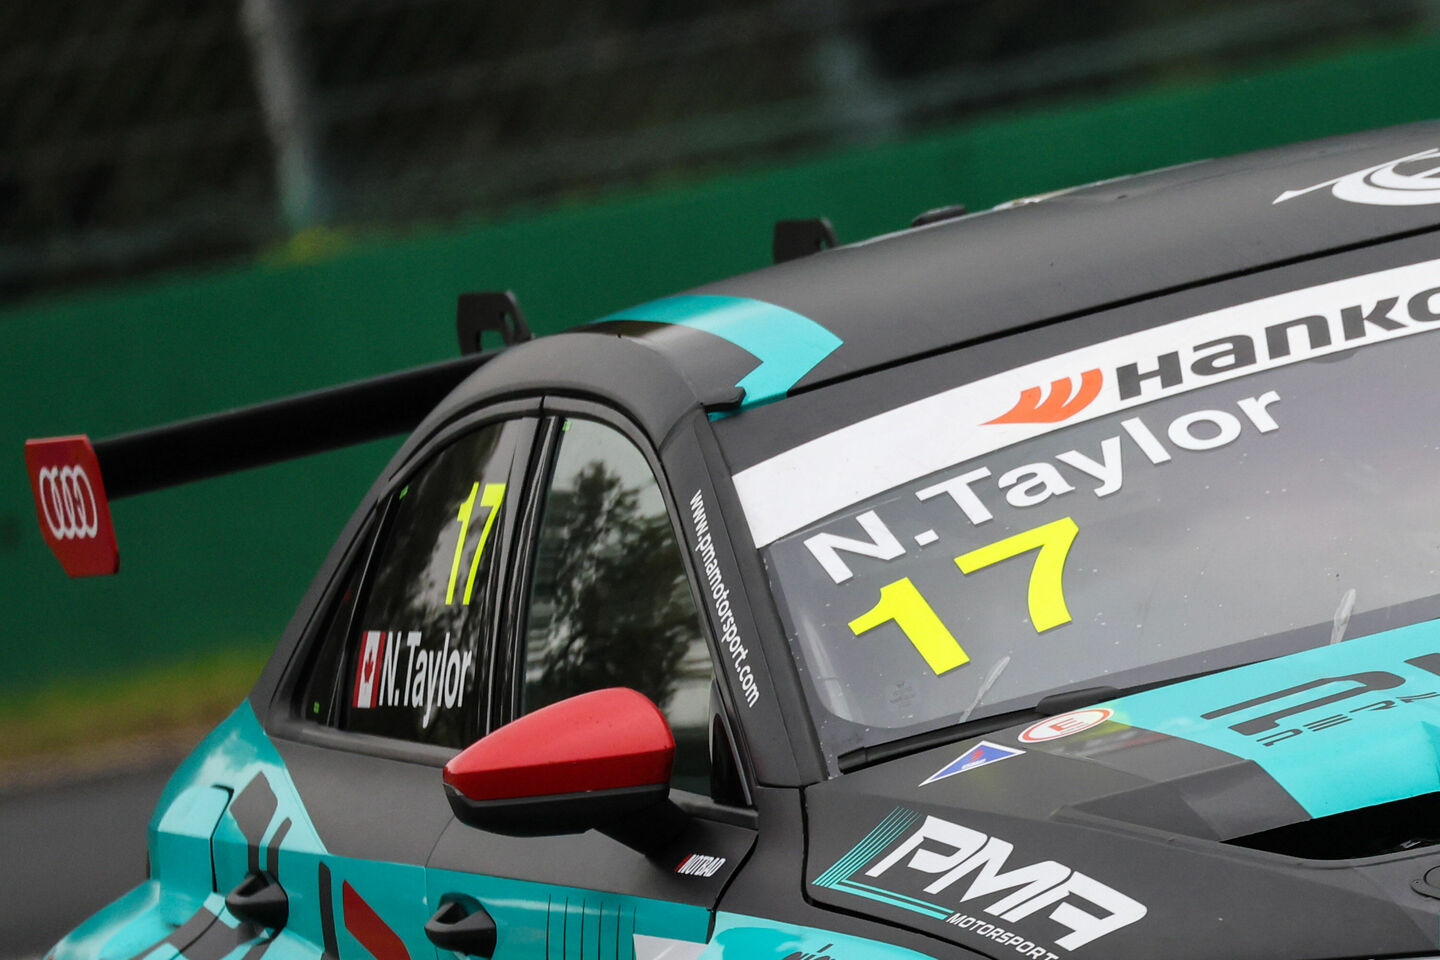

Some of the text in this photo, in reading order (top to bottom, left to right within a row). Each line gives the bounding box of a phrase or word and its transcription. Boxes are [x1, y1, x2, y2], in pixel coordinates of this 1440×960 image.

[445, 482, 506, 605] 17
[690, 489, 761, 708] www.pmamotorsport.com
[847, 516, 1080, 677] 17
